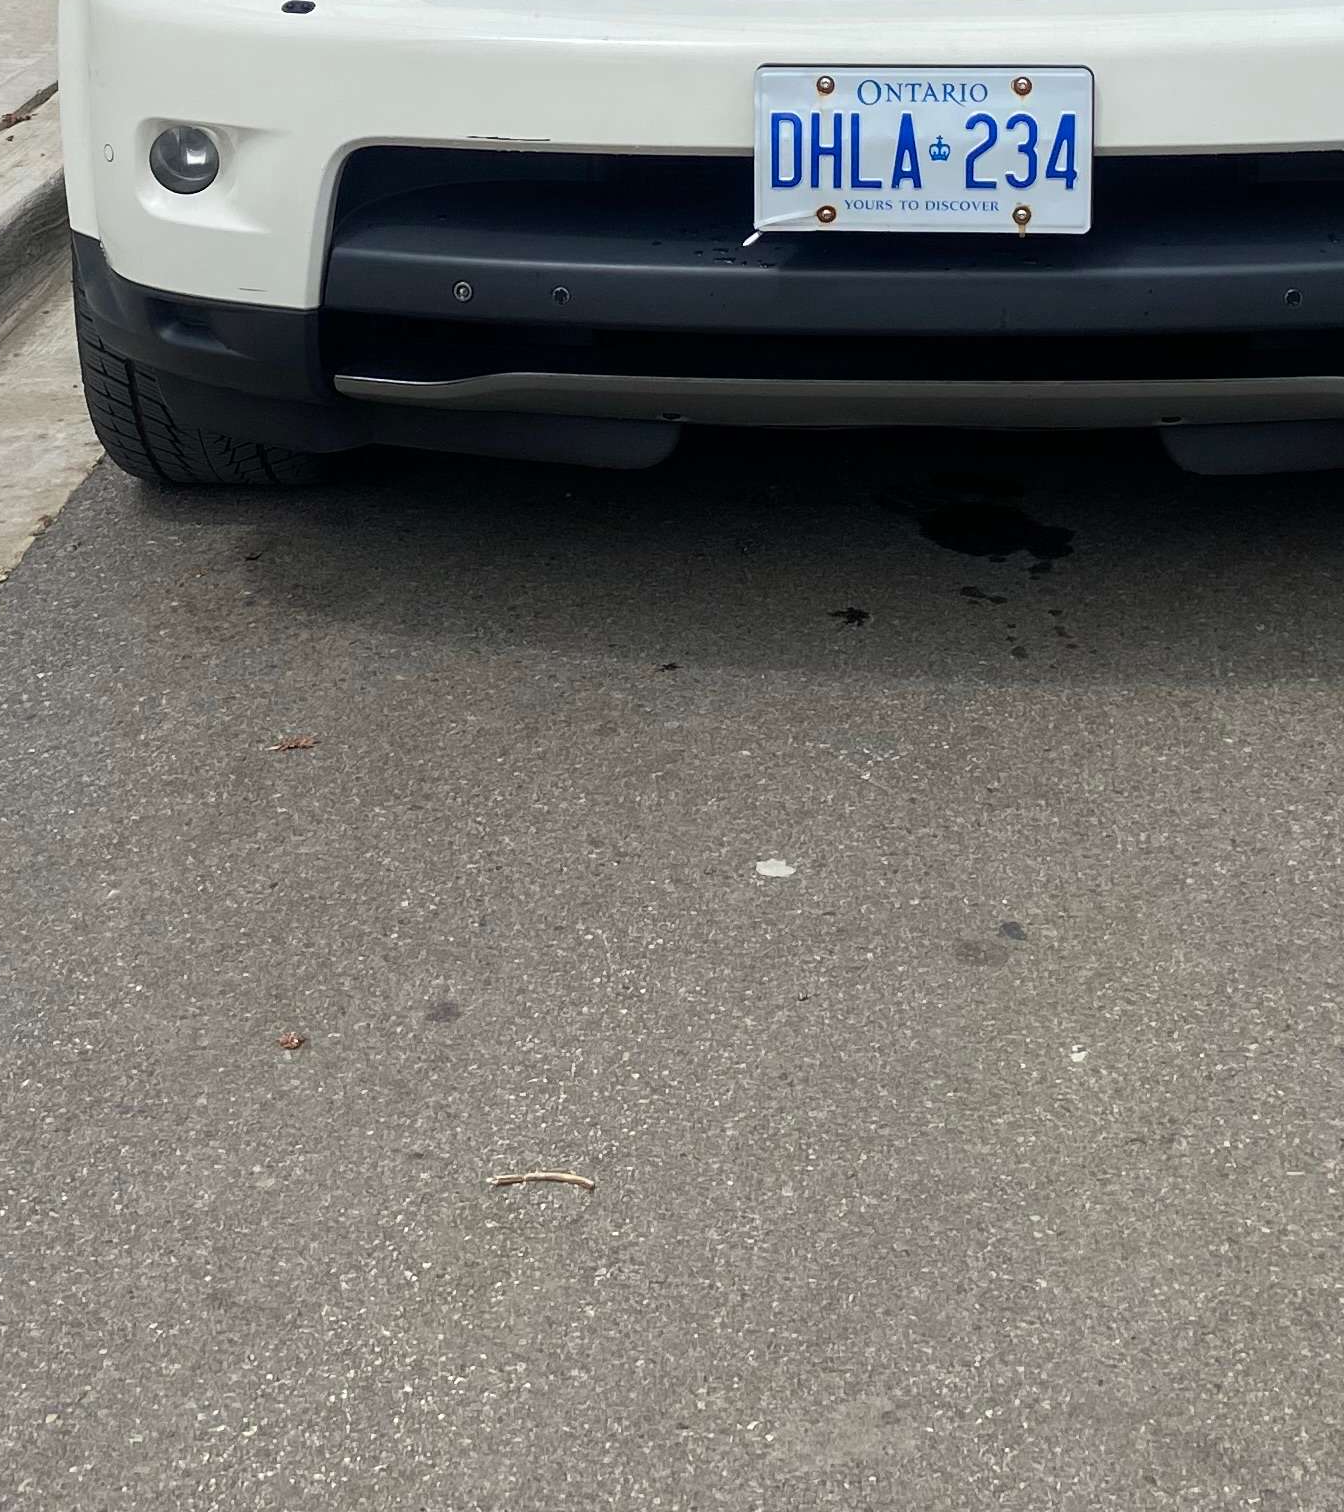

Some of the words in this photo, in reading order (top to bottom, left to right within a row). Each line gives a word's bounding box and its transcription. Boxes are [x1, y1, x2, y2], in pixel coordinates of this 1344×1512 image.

[856, 78, 988, 107] ONTARIO
[770, 111, 923, 190] DHLA
[964, 111, 1078, 190] 234
[844, 199, 893, 212] YOURS
[899, 199, 919, 212] TO
[924, 199, 1000, 213] DISCOVER
